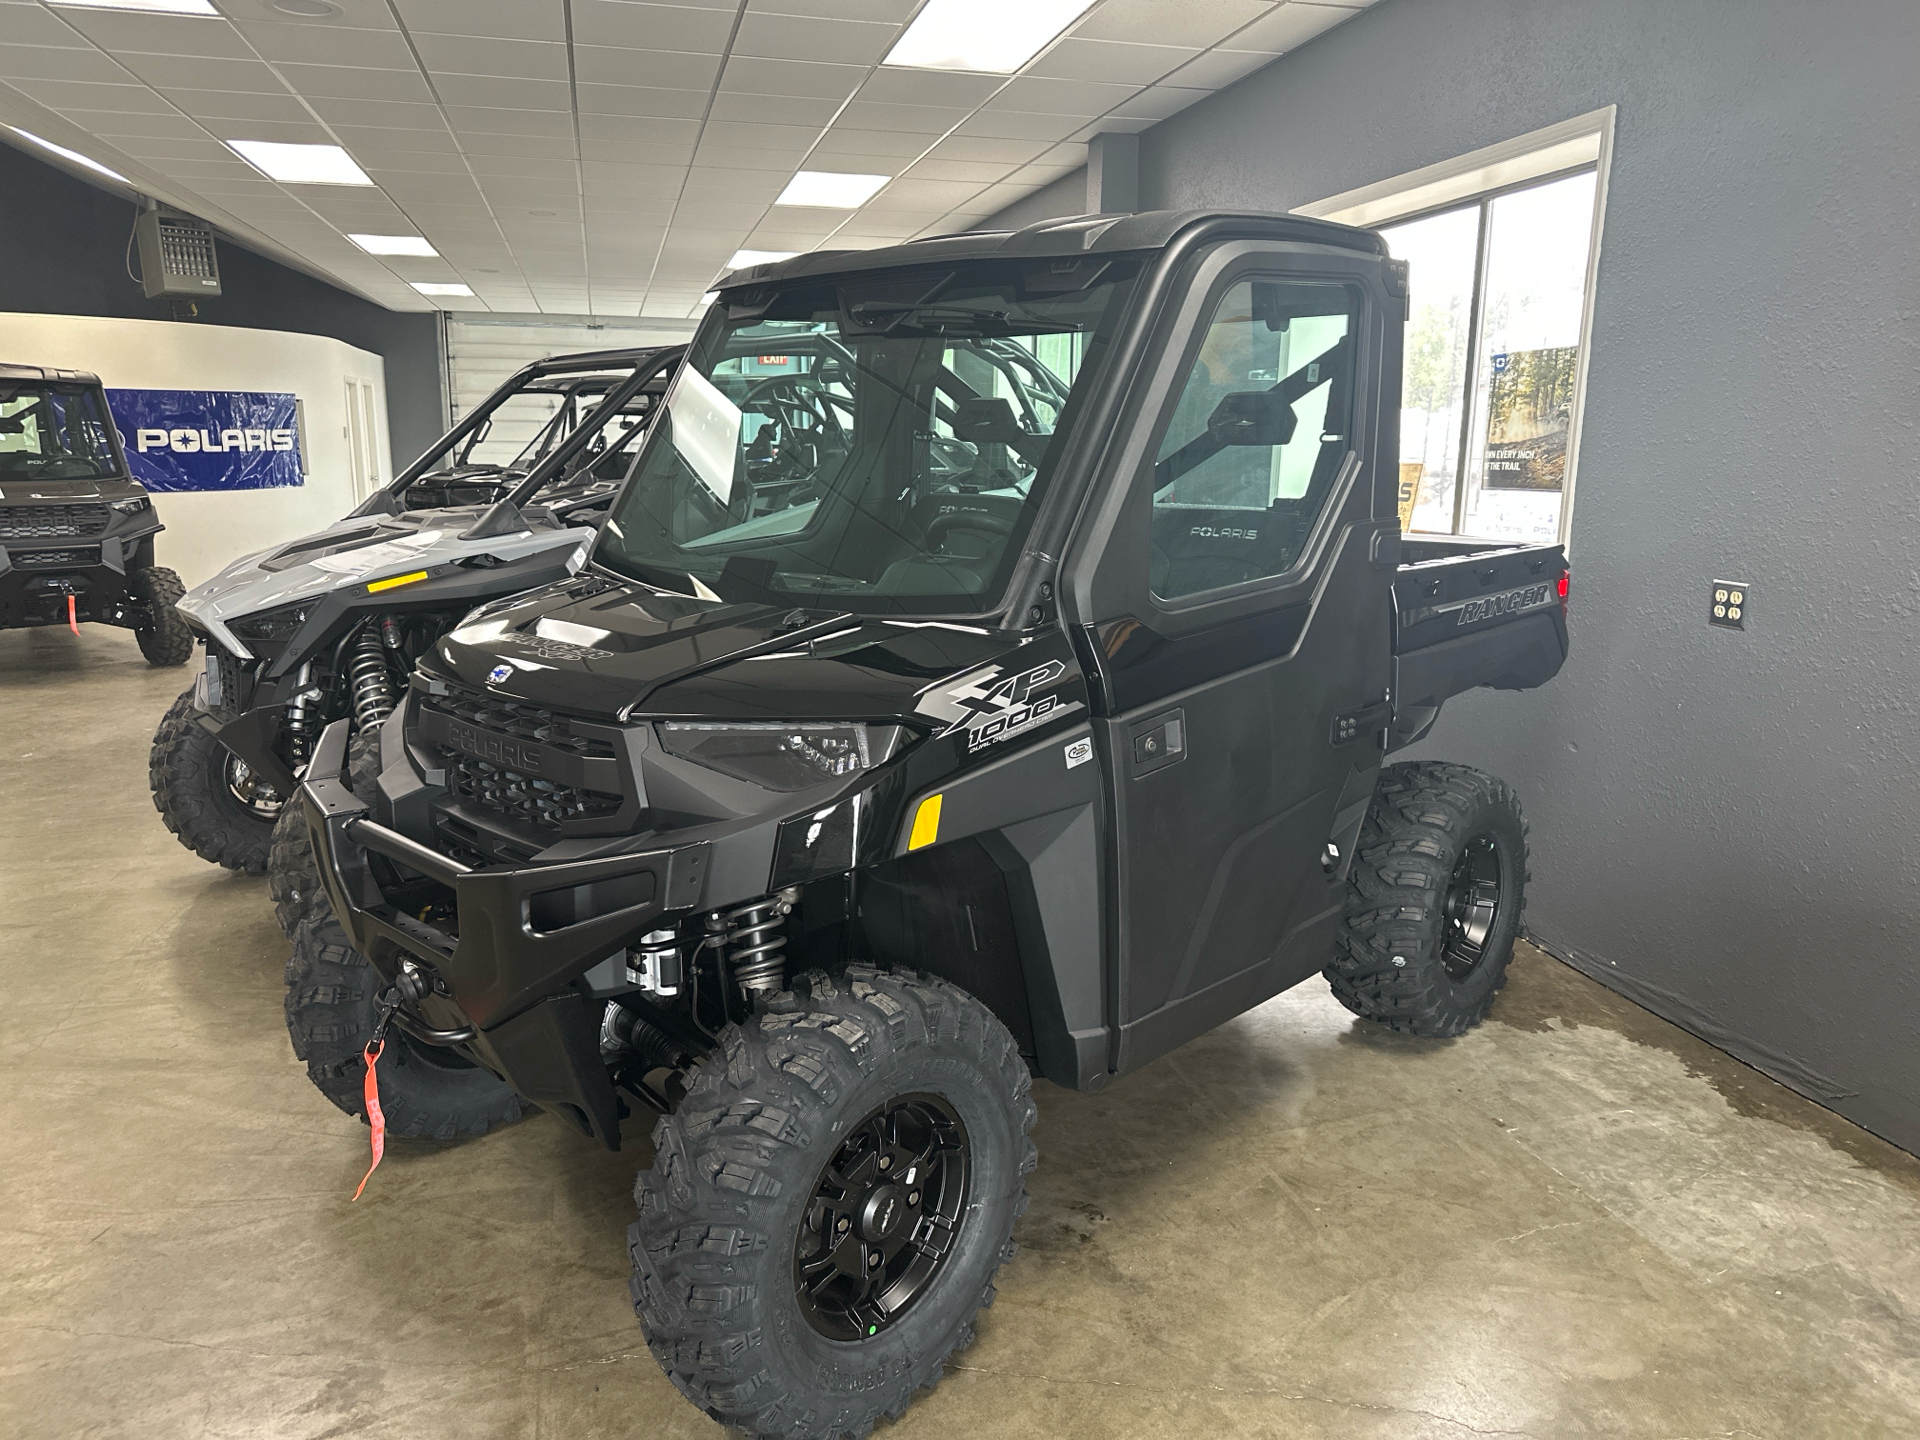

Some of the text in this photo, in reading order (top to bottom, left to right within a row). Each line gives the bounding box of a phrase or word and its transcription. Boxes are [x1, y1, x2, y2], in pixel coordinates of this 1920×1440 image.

[137, 428, 293, 453] POLARIS
[1496, 450, 1517, 459] EVERY
[1517, 450, 1535, 459] INCH
[1490, 462, 1501, 470] THE
[1501, 462, 1521, 471] TRAIL
[1190, 526, 1258, 540] POLARIS
[1457, 583, 1550, 626] RANGER
[935, 658, 1067, 741] XP
[967, 694, 1058, 749] 1000
[969, 713, 1054, 754] DUAL OVERHEAD CAM
[449, 722, 541, 773] POLARIS
[367, 1098, 385, 1165] POLAR
